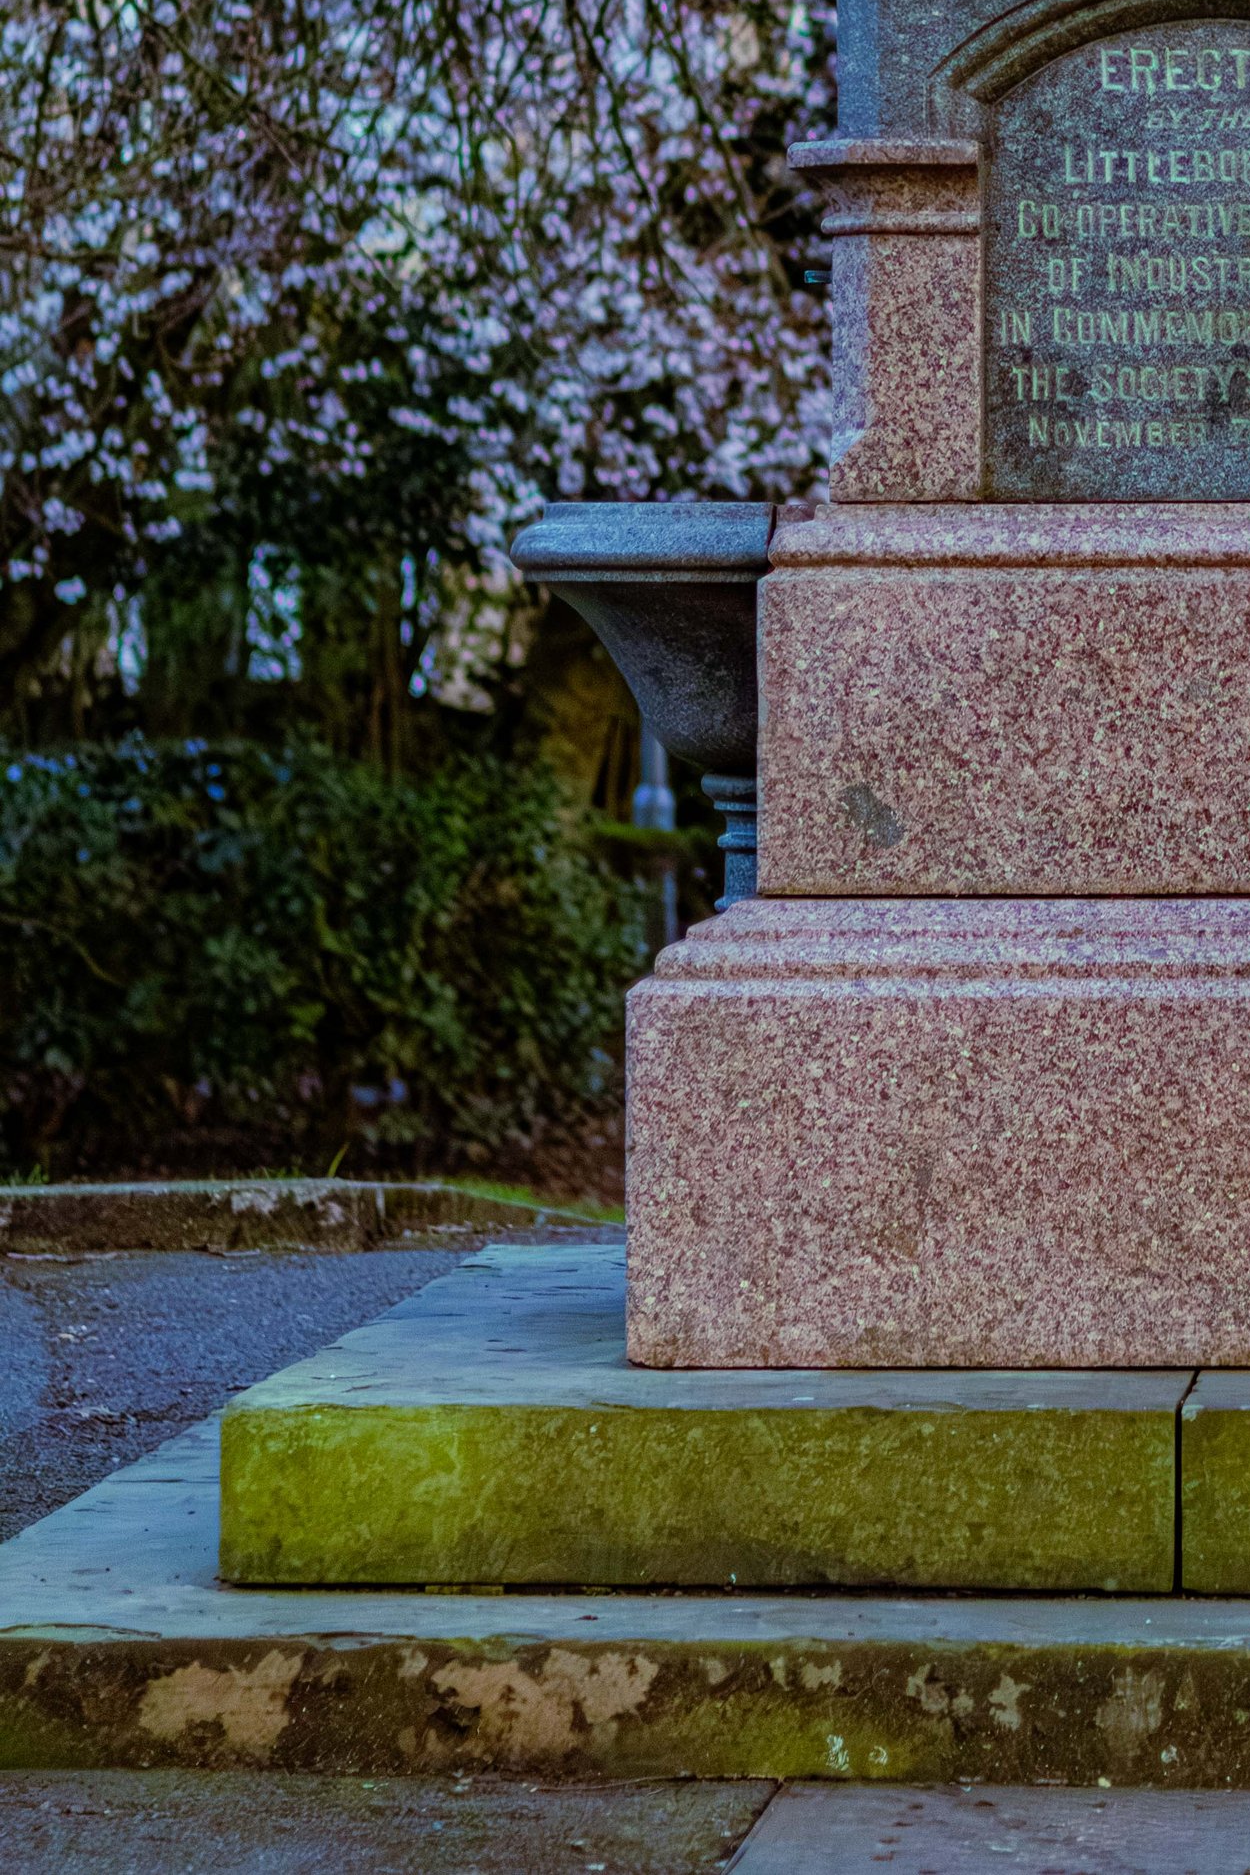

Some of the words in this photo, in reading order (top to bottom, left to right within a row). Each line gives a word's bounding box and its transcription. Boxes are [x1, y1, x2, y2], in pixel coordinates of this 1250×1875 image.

[1147, 107, 1190, 128] BY
[1048, 257, 1085, 294] OF
[1001, 311, 1030, 345] IN
[1013, 365, 1072, 402] THE
[1029, 414, 1208, 448] NOVEMBER
